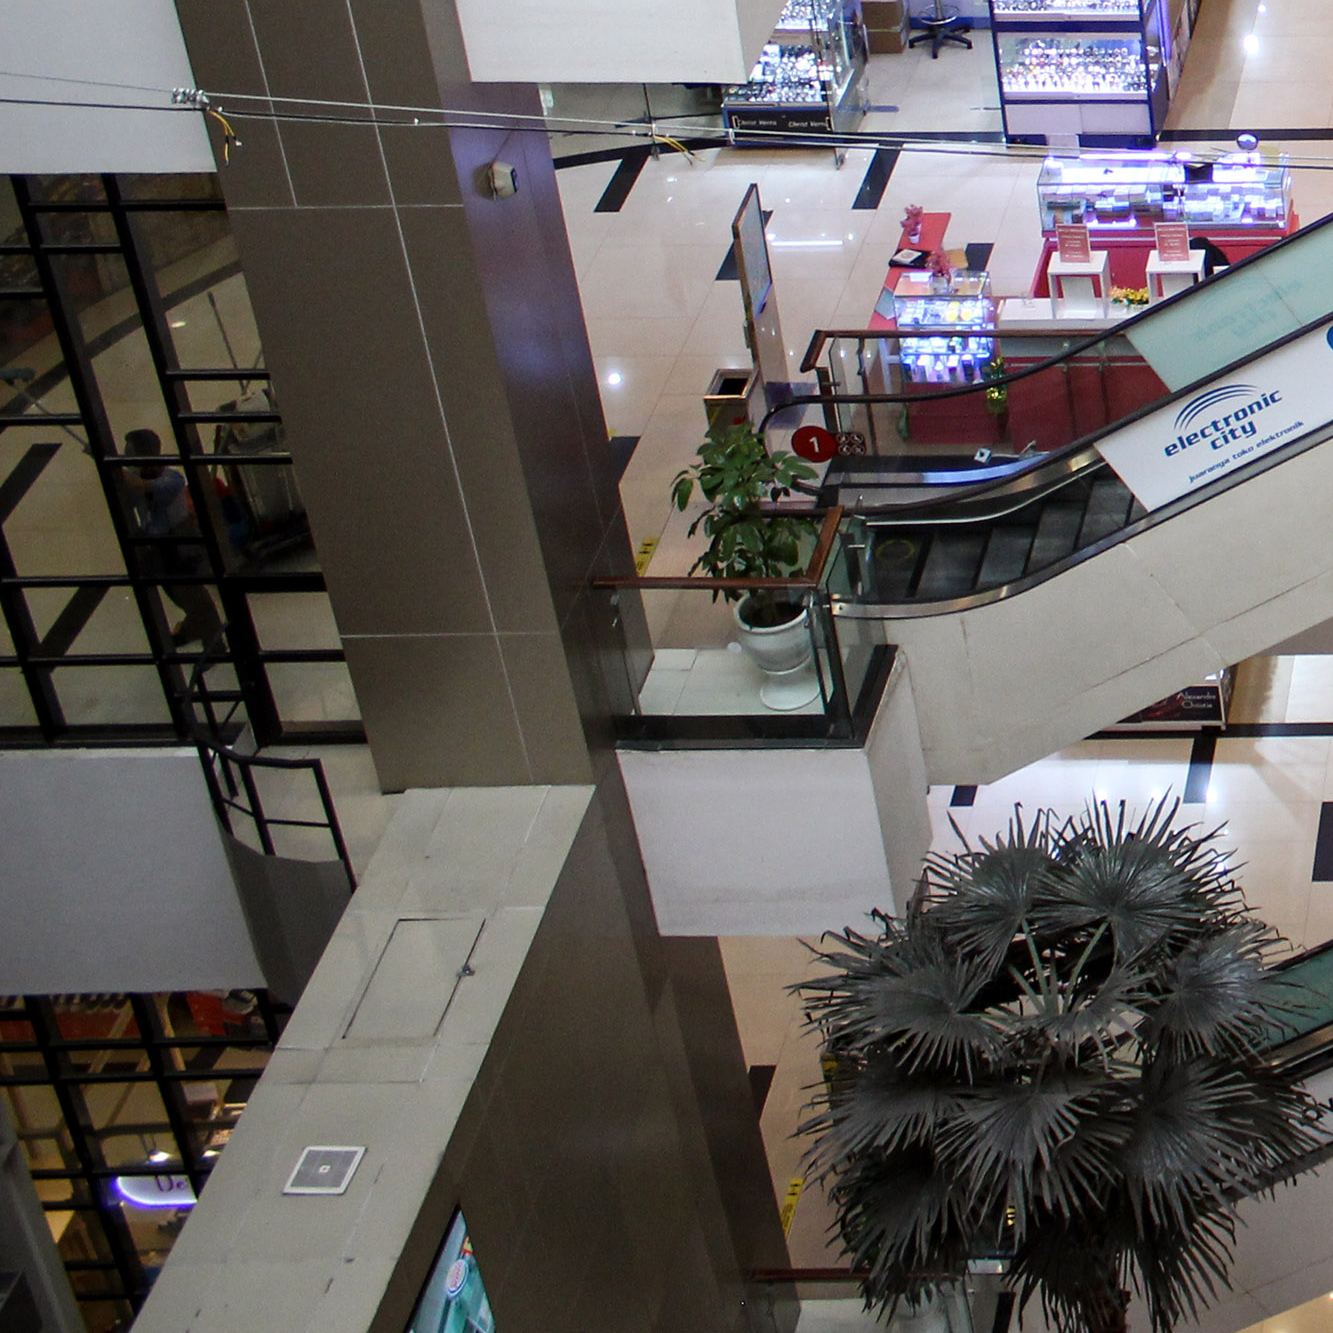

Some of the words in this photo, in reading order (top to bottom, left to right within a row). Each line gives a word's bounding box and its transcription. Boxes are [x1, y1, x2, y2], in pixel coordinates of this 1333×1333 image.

[808, 436, 820, 453] 1
[1164, 389, 1283, 457] electronic
[1210, 420, 1257, 451] city
[1188, 457, 1231, 484] juaranya
[1232, 446, 1254, 460] toko
[1256, 421, 1304, 449] elektronik
